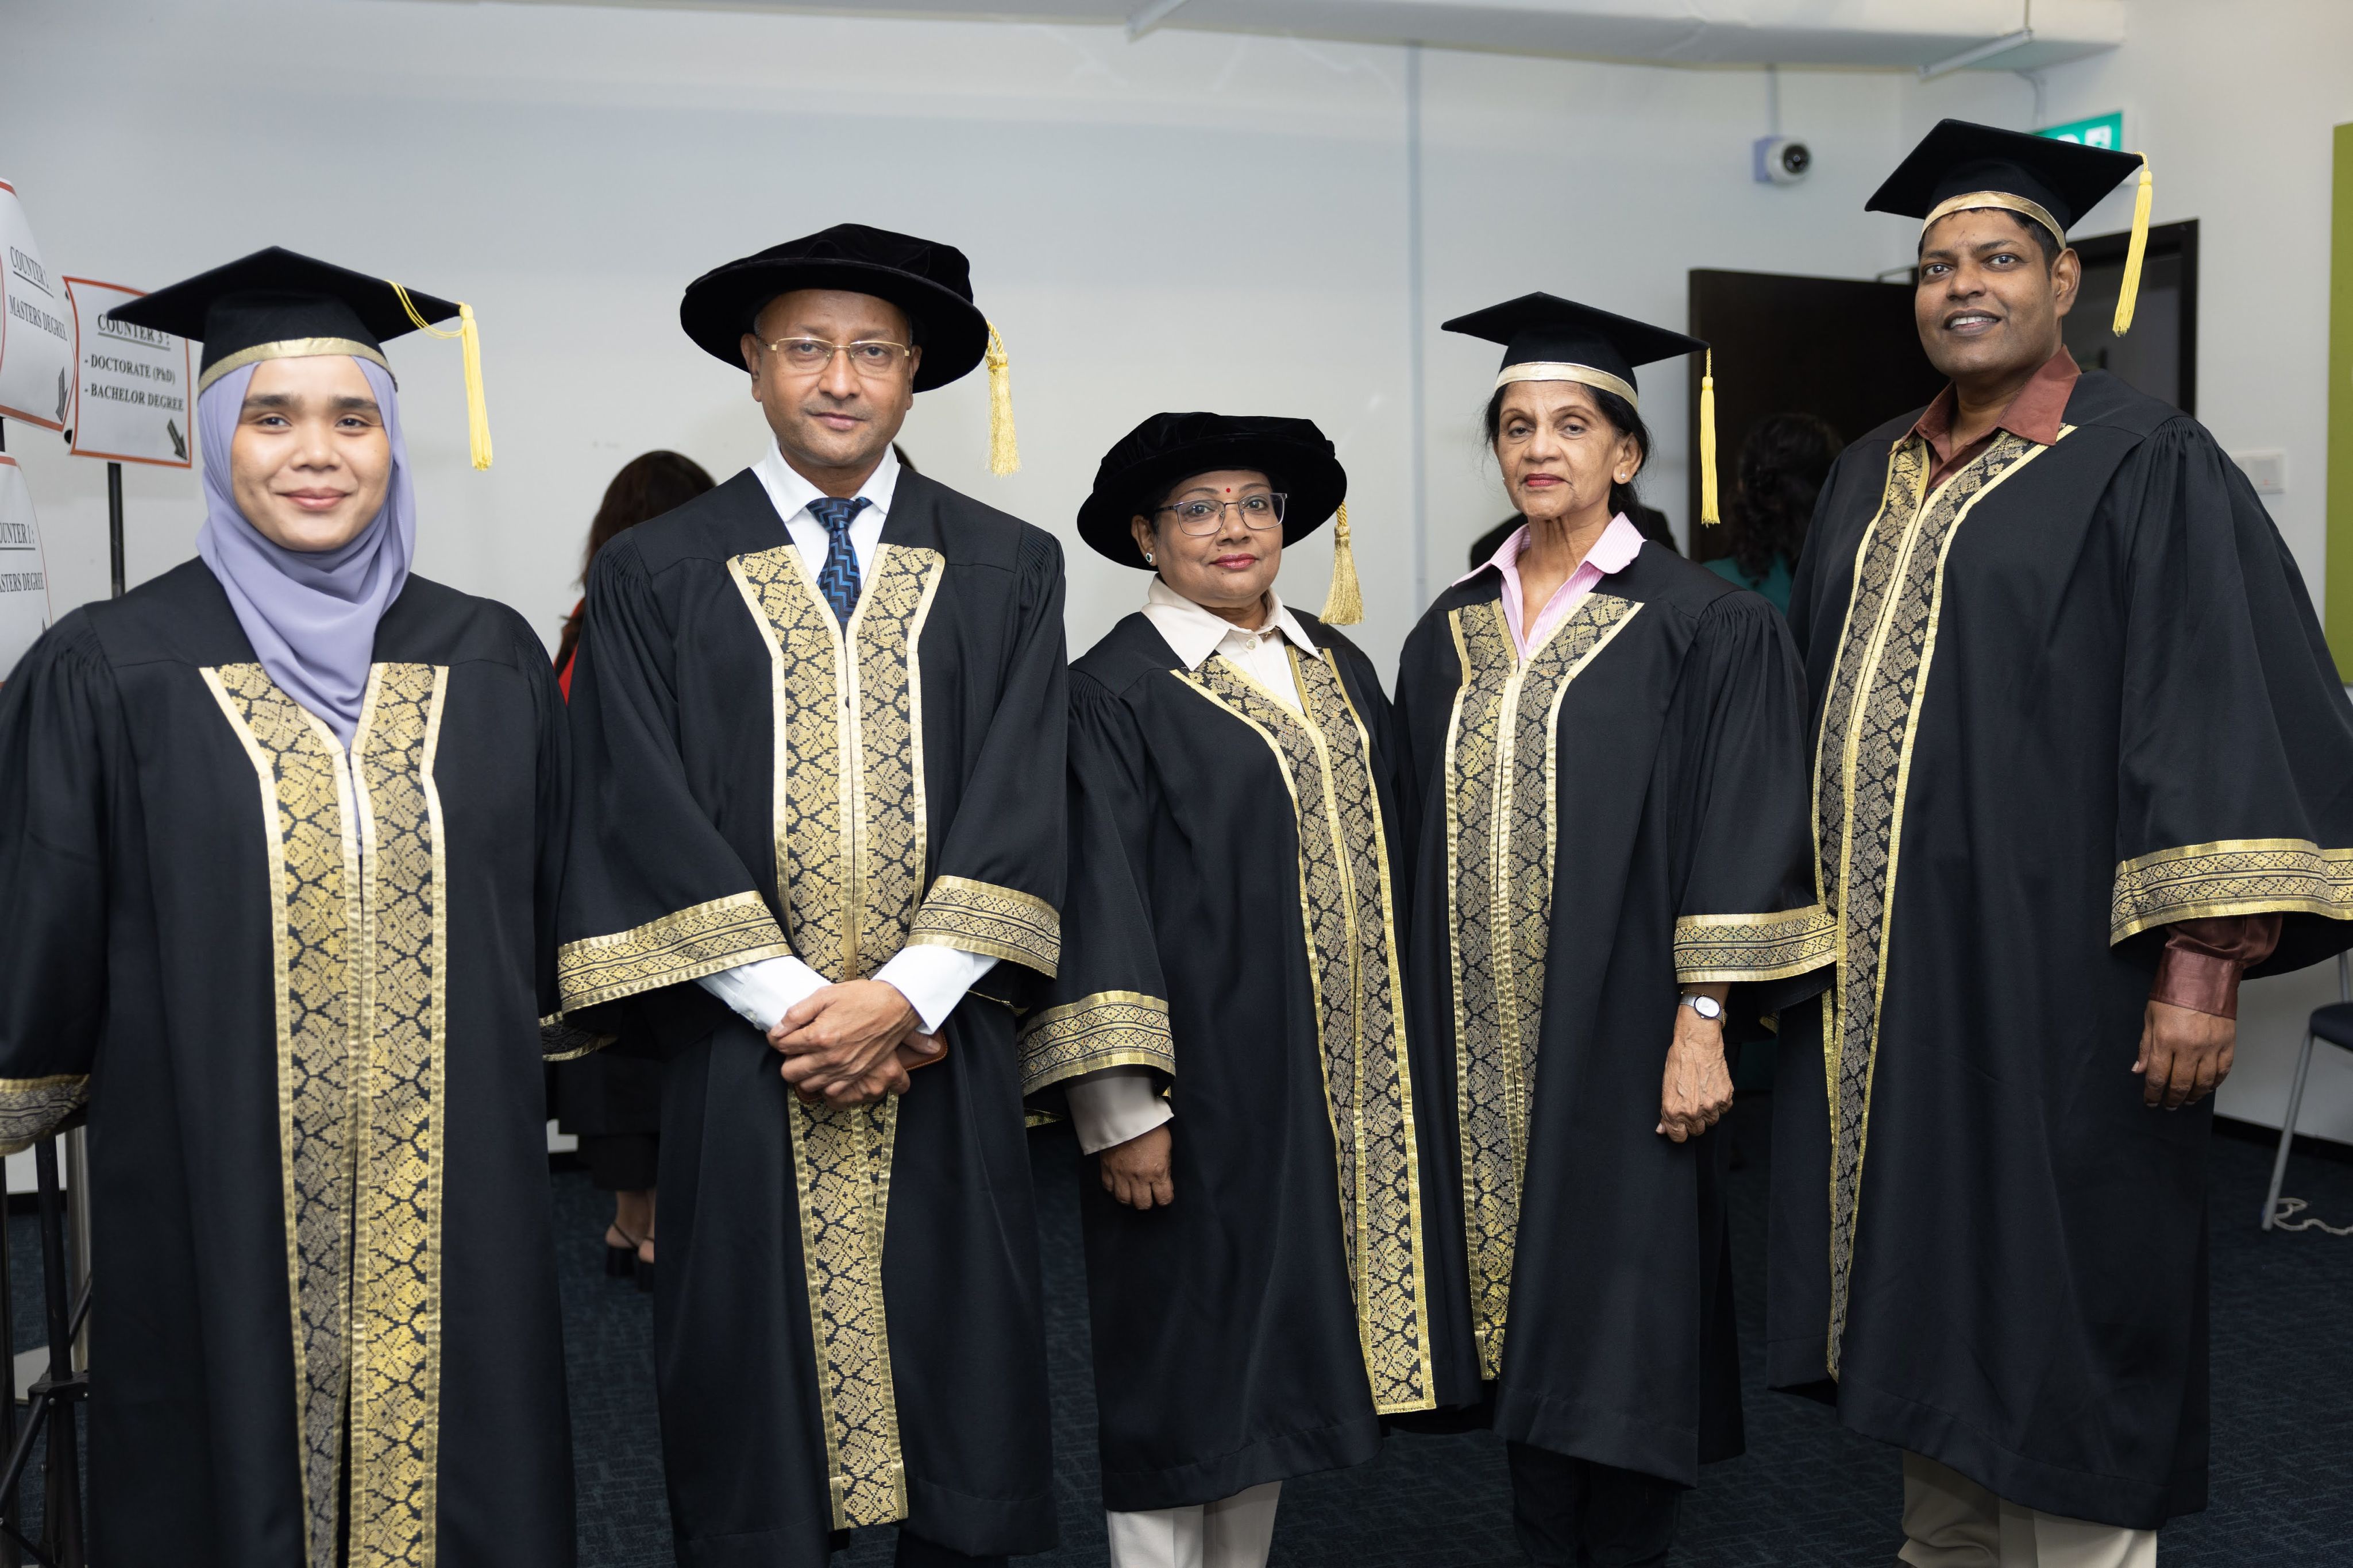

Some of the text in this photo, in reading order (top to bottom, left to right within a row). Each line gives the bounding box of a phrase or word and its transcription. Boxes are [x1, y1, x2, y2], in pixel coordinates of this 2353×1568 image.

[10, 246, 46, 287] COUNTER
[9, 294, 68, 341] MASTERS DEGREE
[97, 314, 155, 342] COUNTER
[91, 353, 151, 379] DOCTORATE
[153, 366, 176, 385] (PhD)
[91, 382, 145, 405] BACHELOR
[147, 392, 184, 412] DEGREE
[0, 522, 28, 544] OUNTER
[0, 572, 44, 593] STERS DEGREE
